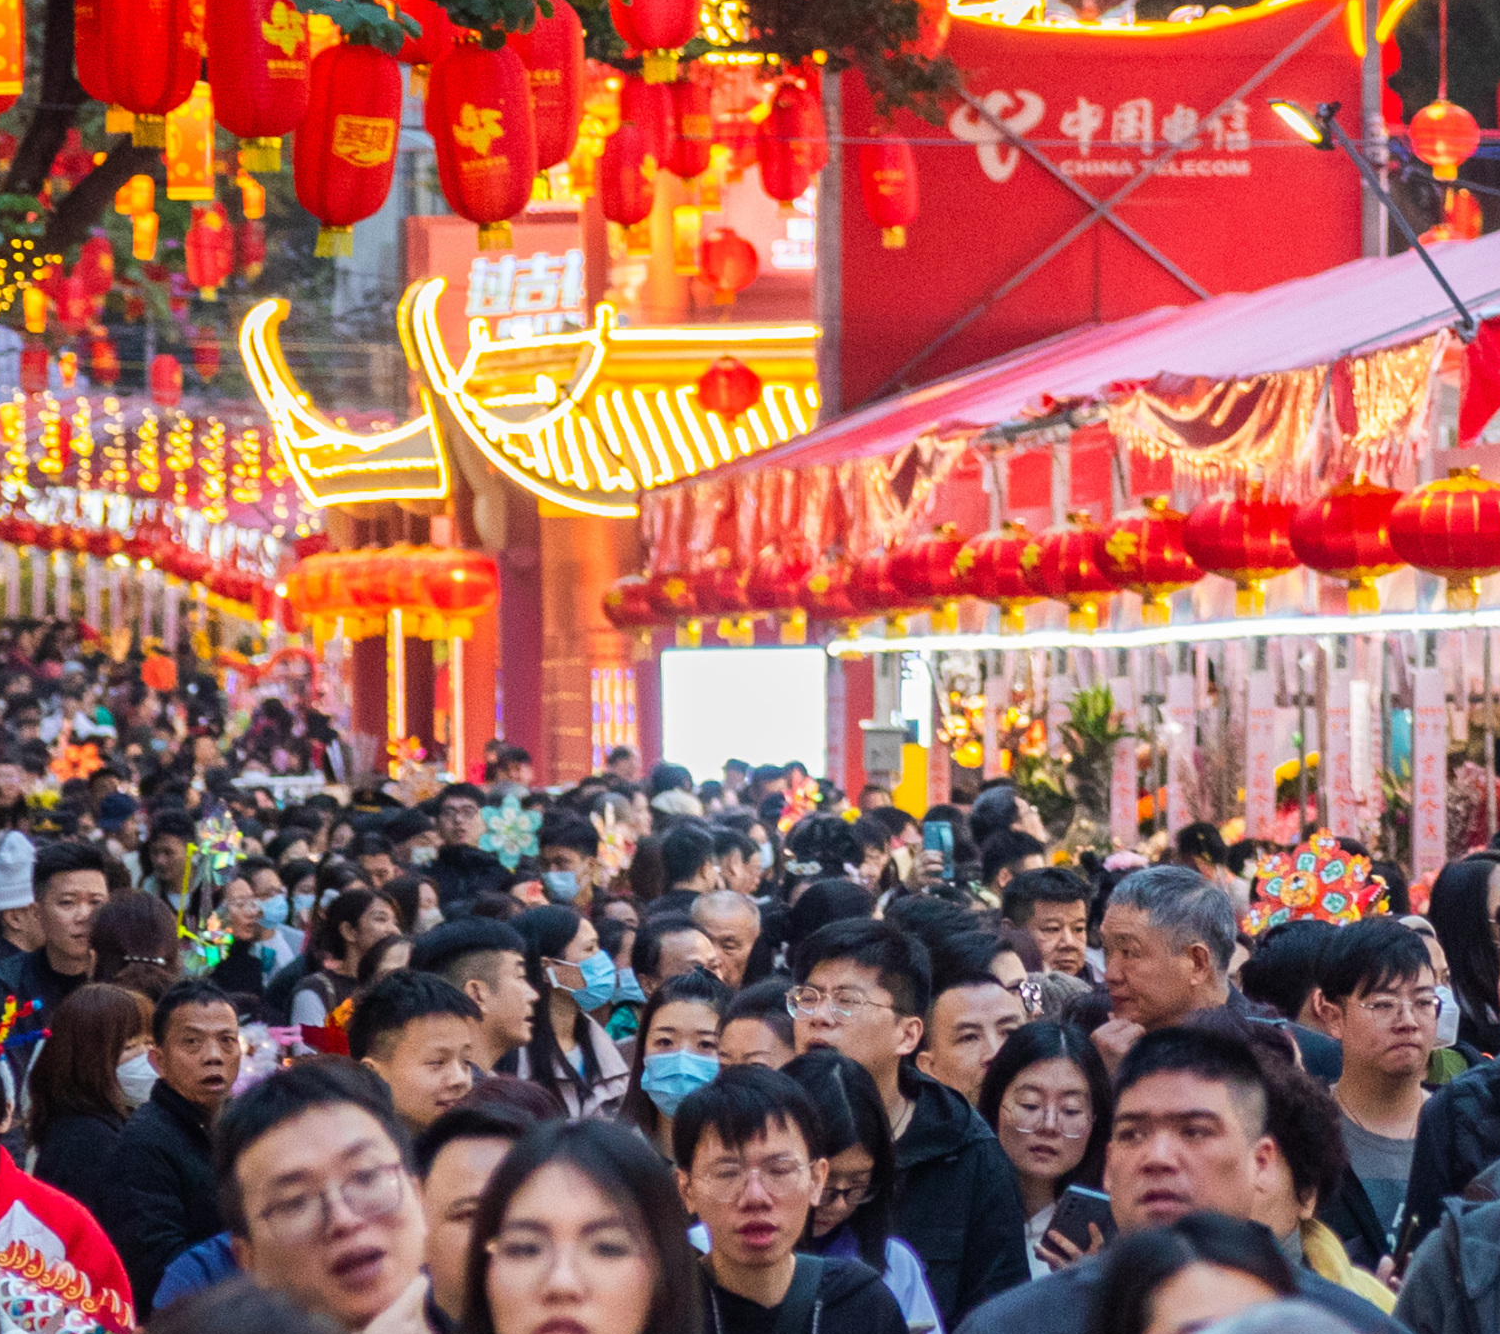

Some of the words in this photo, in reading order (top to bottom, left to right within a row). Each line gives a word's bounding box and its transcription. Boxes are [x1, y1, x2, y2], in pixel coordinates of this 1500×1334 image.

[1059, 96, 1249, 156] 中国电信
[1059, 160, 1135, 177] CHINA
[1140, 160, 1250, 177] TELECOM
